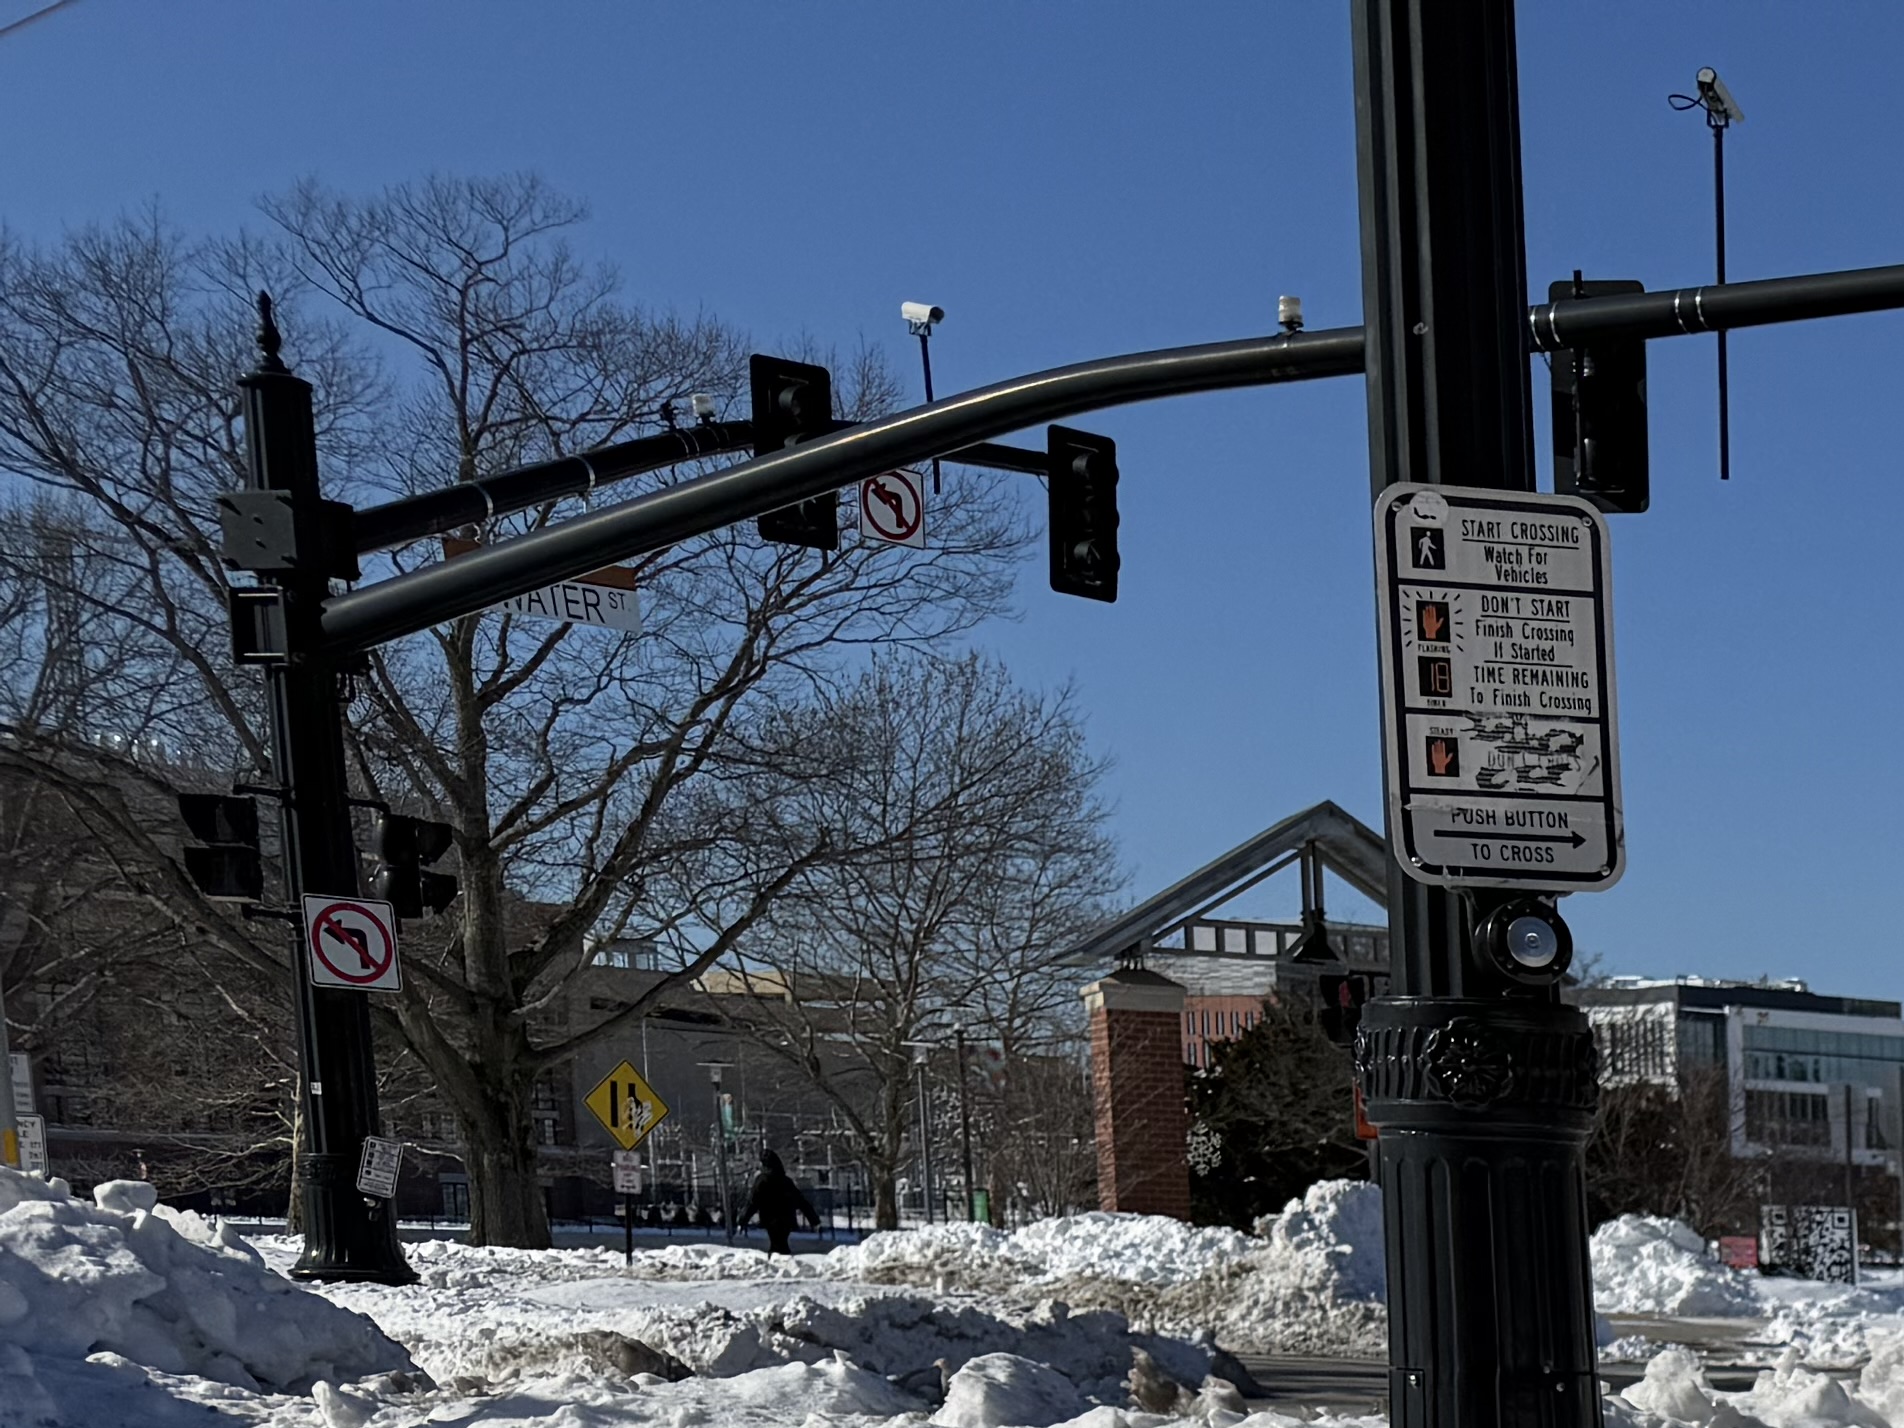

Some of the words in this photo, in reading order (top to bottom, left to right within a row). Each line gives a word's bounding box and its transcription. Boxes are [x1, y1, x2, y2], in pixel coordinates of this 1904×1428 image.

[1461, 519, 1502, 539] START
[1511, 521, 1579, 544] CROSSING
[1484, 545, 1522, 565] Watch
[1528, 547, 1548, 565] For
[1495, 564, 1548, 584] Vehicles
[1481, 595, 1521, 614] DON'T
[1531, 599, 1570, 618] START
[1475, 619, 1513, 639] Finish
[1522, 623, 1574, 646] Crossing
[1494, 642, 1503, 659] If
[1511, 643, 1555, 662] Started
[1473, 666, 1505, 685] TIME
[1512, 667, 1589, 689] REMAINING
[1470, 687, 1483, 705] To
[1493, 689, 1530, 708] Finish
[1540, 691, 1591, 715] Crossing
[1451, 808, 1497, 825] PUSH
[1505, 810, 1568, 829] BUTTON
[1471, 843, 1490, 860] TO
[1500, 845, 1554, 863] CROSS
